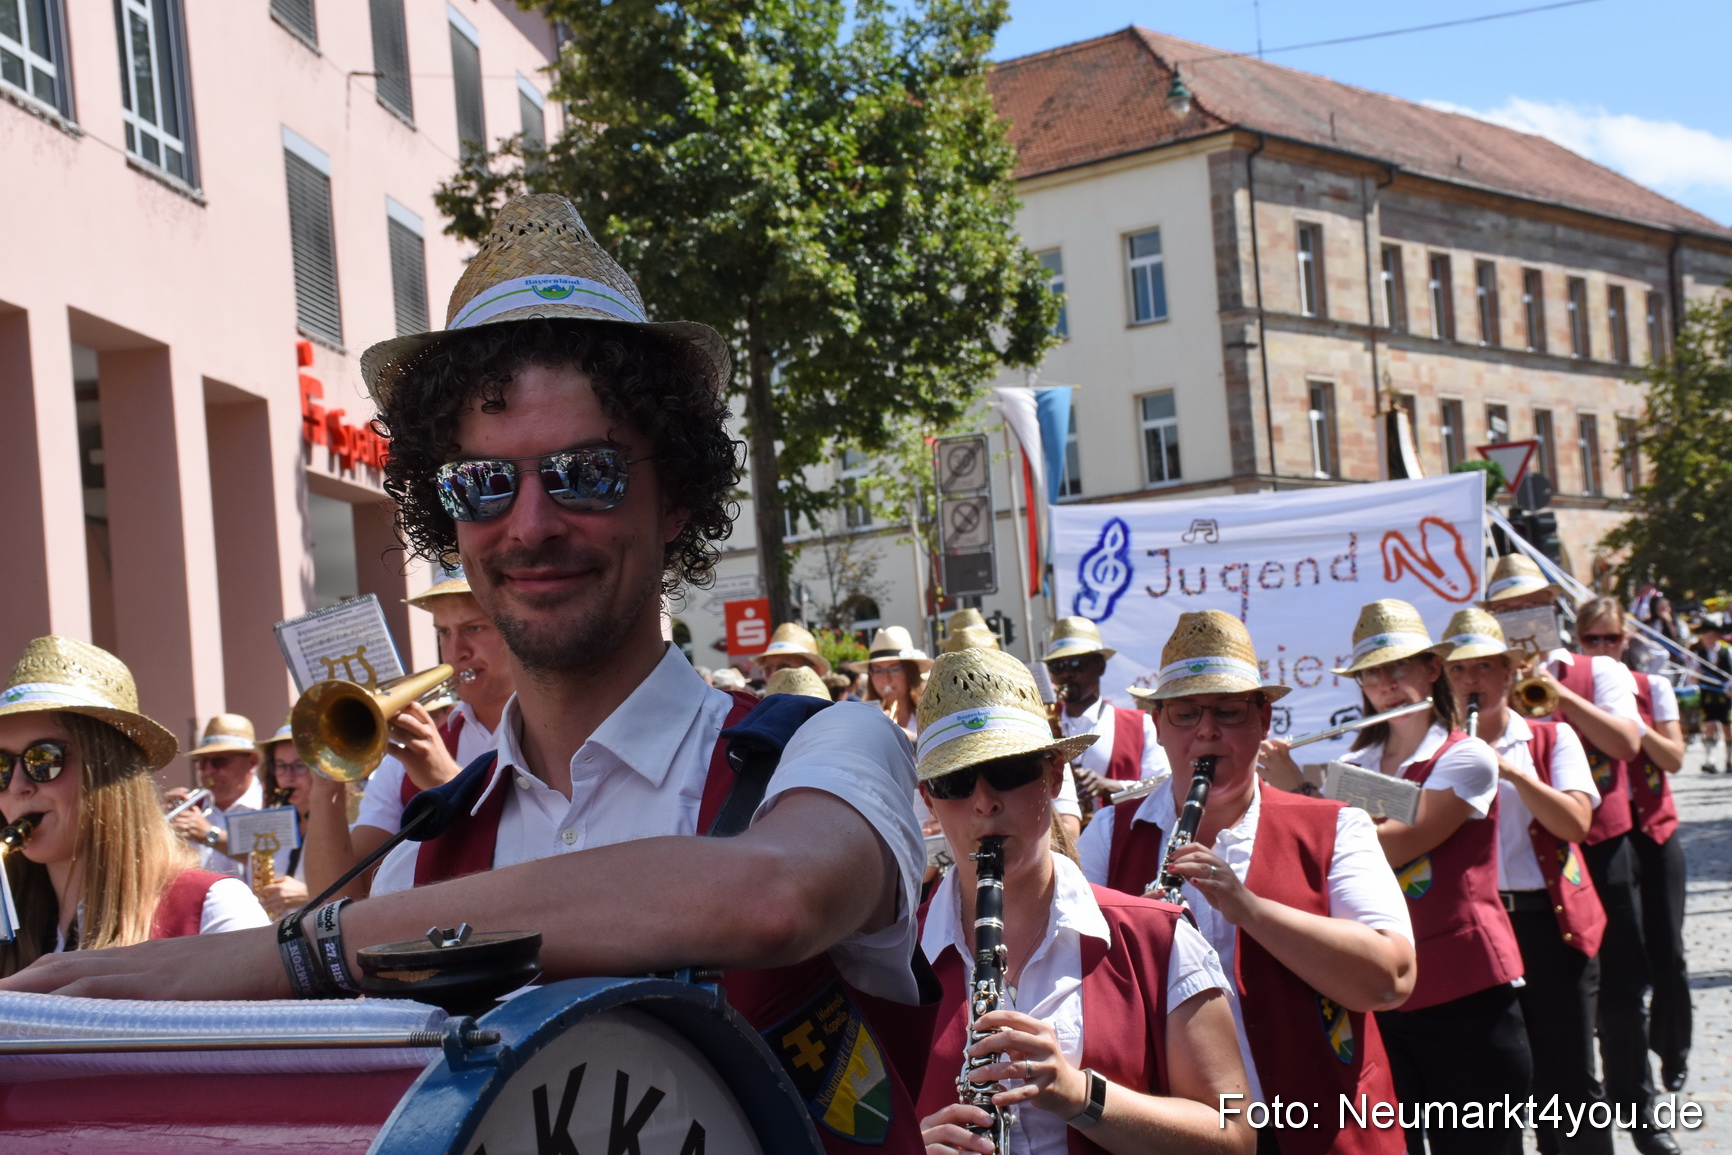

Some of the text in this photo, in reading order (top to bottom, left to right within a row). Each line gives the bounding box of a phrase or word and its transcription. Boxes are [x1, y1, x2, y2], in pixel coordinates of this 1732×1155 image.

[525, 278, 581, 286] Bayernland
[1146, 532, 1358, 623] Jugend
[325, 942, 337, 961] 27.
[330, 963, 344, 982] BIS
[815, 1053, 849, 1107] Neumarkt
